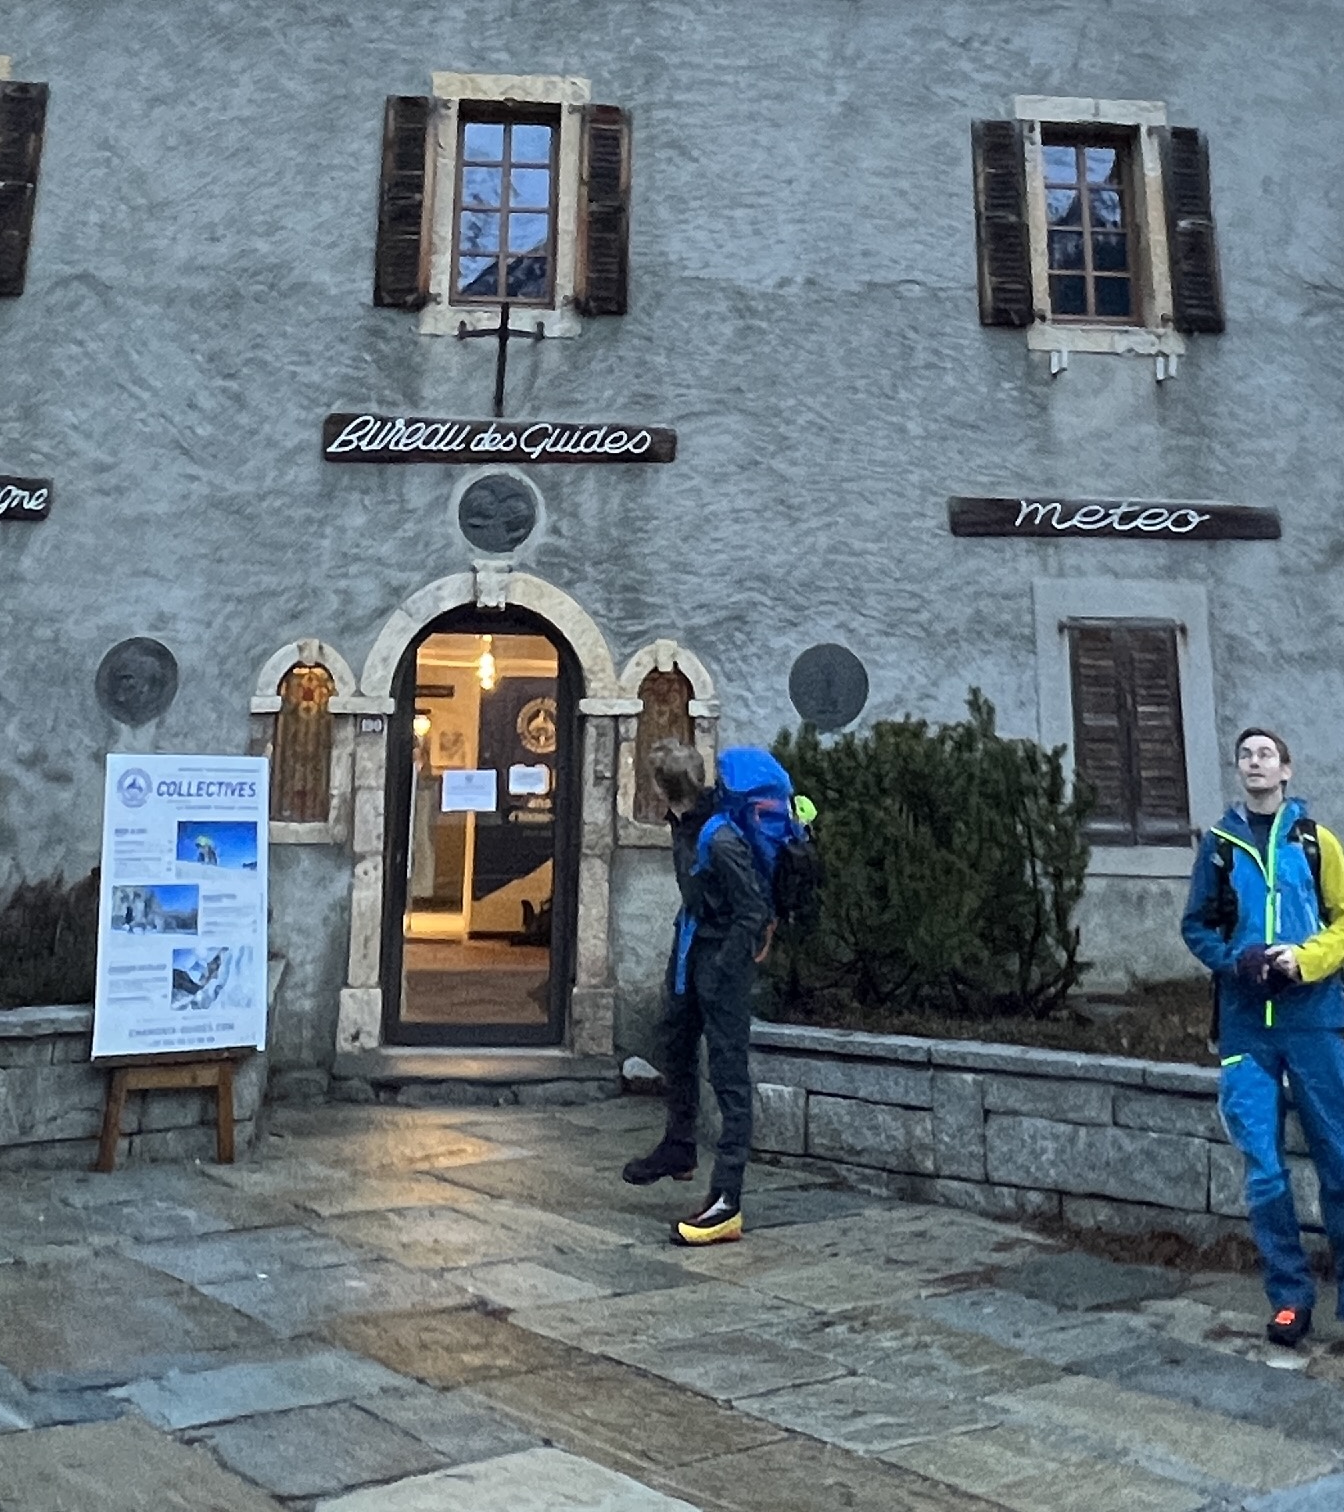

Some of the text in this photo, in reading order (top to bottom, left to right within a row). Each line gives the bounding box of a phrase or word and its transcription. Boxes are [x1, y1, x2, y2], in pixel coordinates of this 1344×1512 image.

[326, 415, 653, 459] Bureau des Guides
[156, 780, 257, 798] COLLECTIVES
